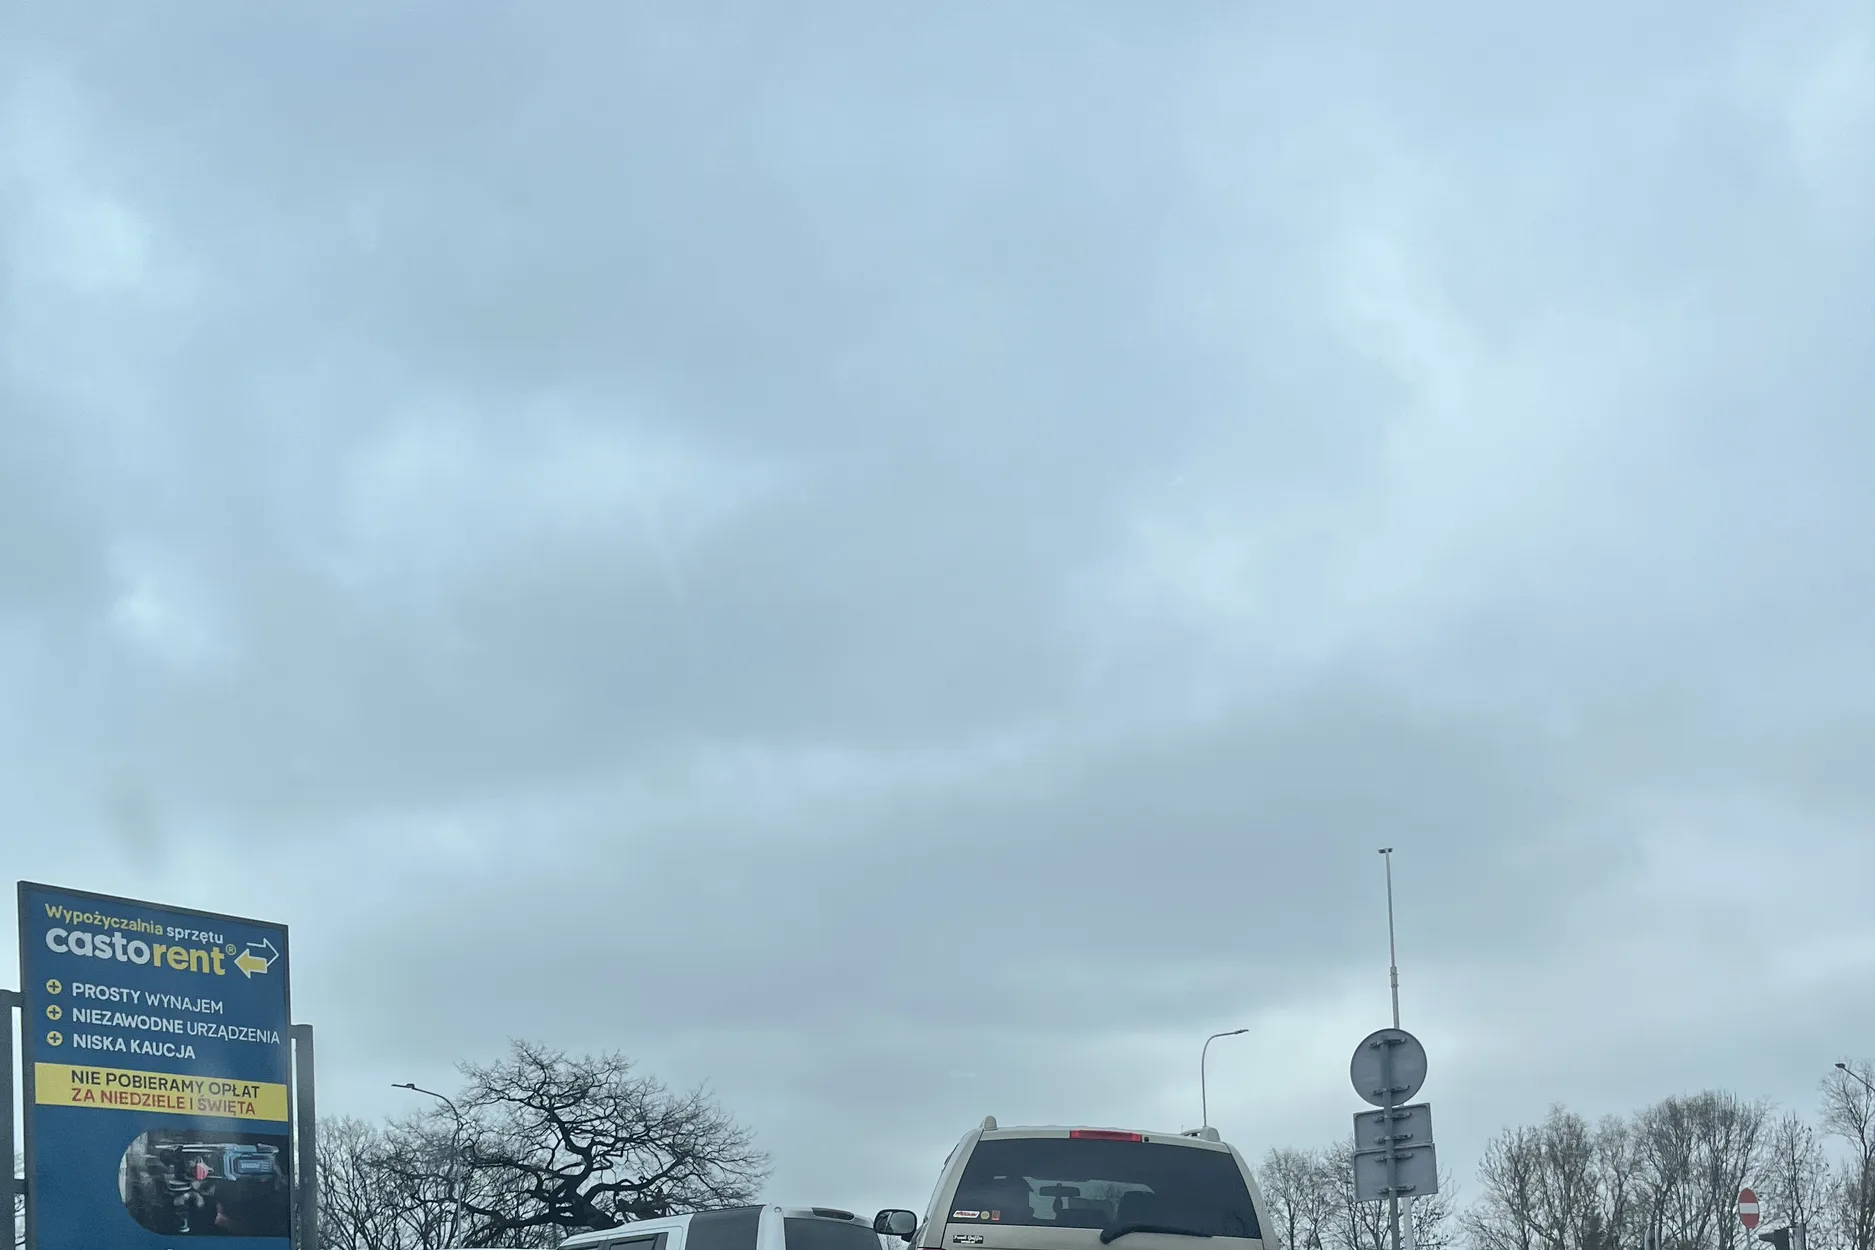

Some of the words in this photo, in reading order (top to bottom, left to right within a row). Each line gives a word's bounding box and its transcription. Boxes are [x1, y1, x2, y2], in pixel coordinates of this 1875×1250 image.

[45, 903, 163, 935] Wypożyczalnia
[166, 925, 224, 945] sprzętu
[72, 982, 141, 1004] PROSTY
[145, 991, 223, 1015] WYNAJEM
[72, 1007, 184, 1034] NIEZAWODNE
[187, 1021, 280, 1045] URZĄDZENIA
[73, 1034, 127, 1053] NISKA
[130, 1040, 196, 1060] KAUCJA
[71, 1070, 101, 1086] NIE
[106, 1072, 204, 1094] POBIERAMY
[208, 1082, 260, 1099] OPŁAT
[71, 1088, 96, 1103] ZA
[100, 1091, 187, 1110] NIEDZIELE
[189, 1096, 194, 1110] I
[197, 1095, 256, 1116] ŚWIĘTA
